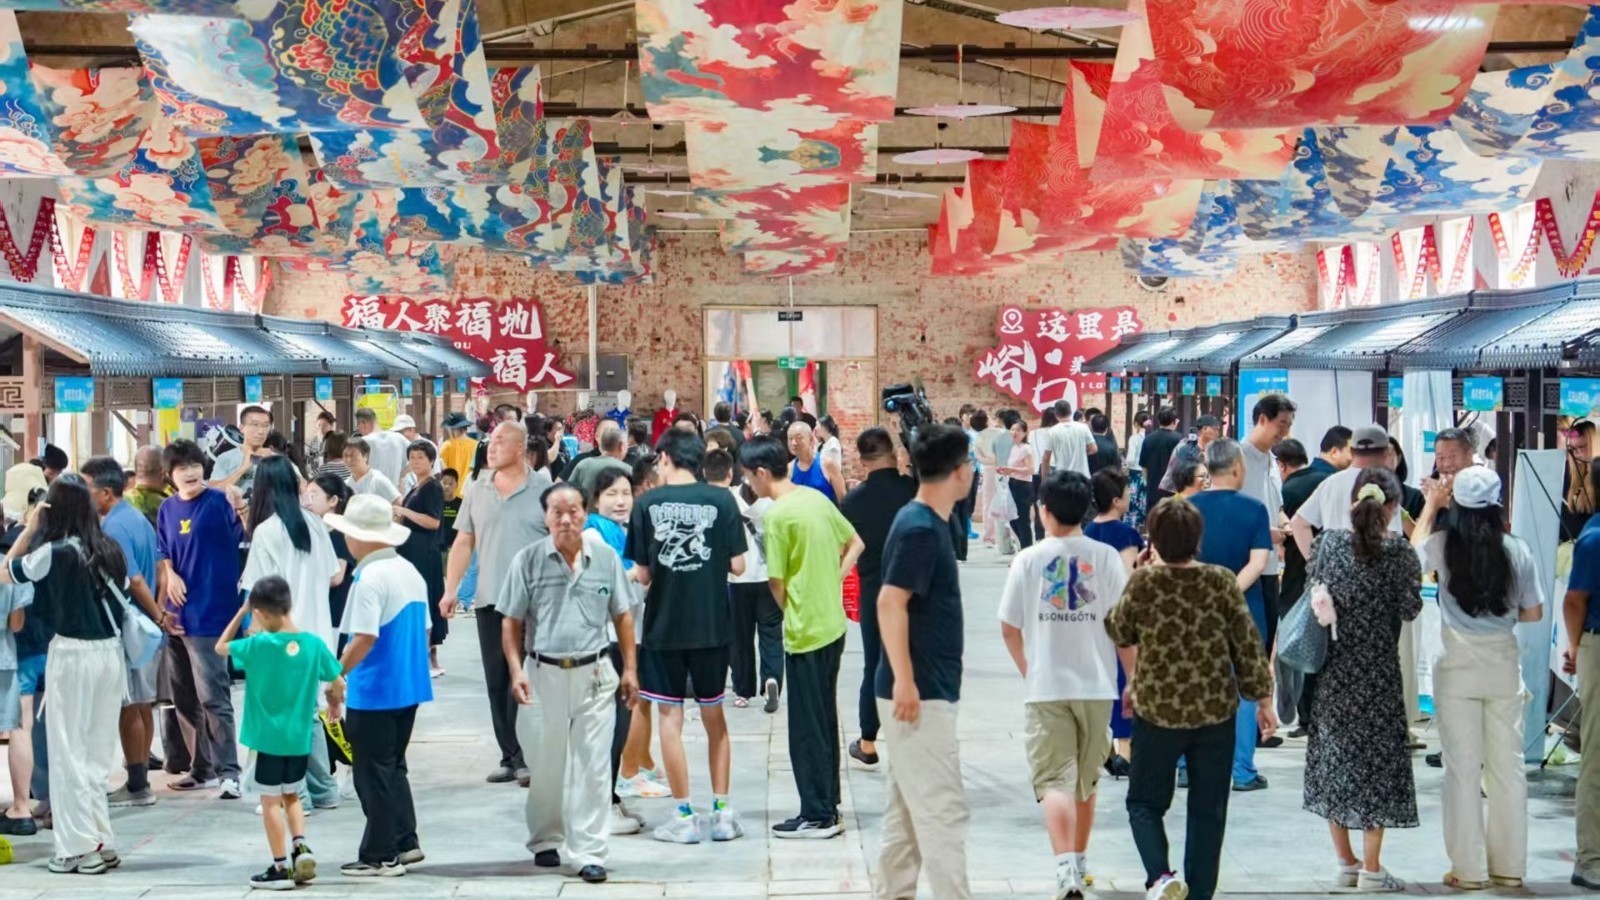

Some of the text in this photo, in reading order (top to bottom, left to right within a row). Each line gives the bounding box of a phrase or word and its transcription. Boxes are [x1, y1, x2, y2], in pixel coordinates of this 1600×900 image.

[346, 296, 543, 342] 福人聚福地
[1036, 310, 1139, 343] 这里是
[470, 347, 574, 391] 福人
